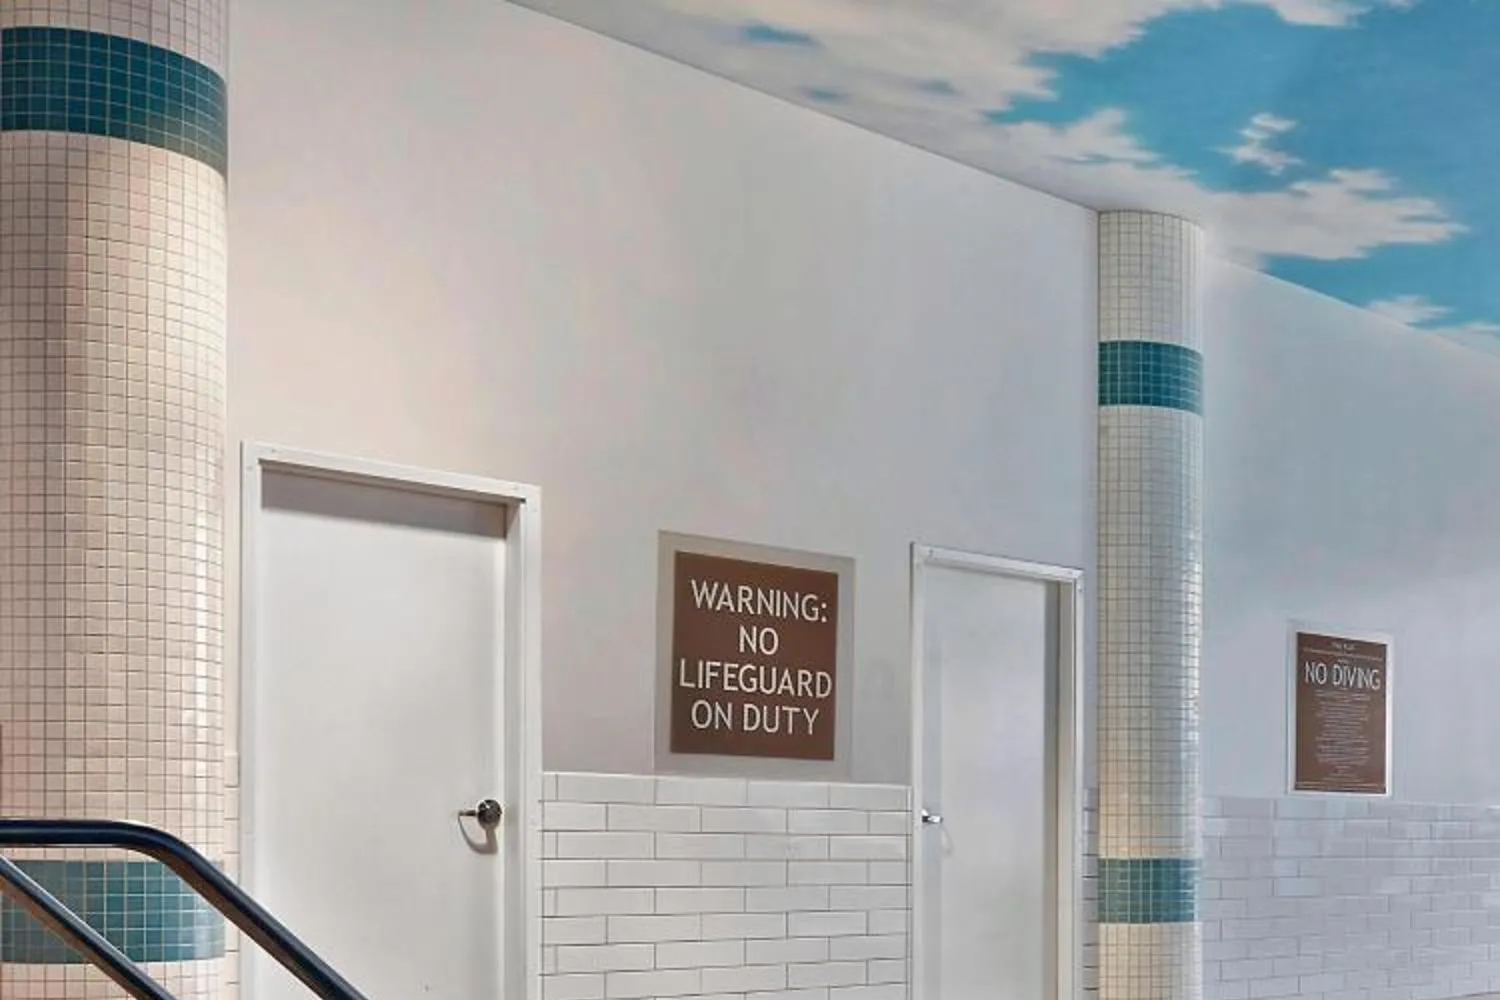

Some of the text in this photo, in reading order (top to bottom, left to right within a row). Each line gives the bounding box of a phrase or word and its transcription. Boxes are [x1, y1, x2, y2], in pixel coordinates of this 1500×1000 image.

[691, 579, 827, 622] WARNING:
[739, 625, 779, 655] NO
[679, 659, 832, 697] LIFEGUARD
[1305, 661, 1380, 690] NO DIVING
[691, 699, 819, 735] ON DUTY
